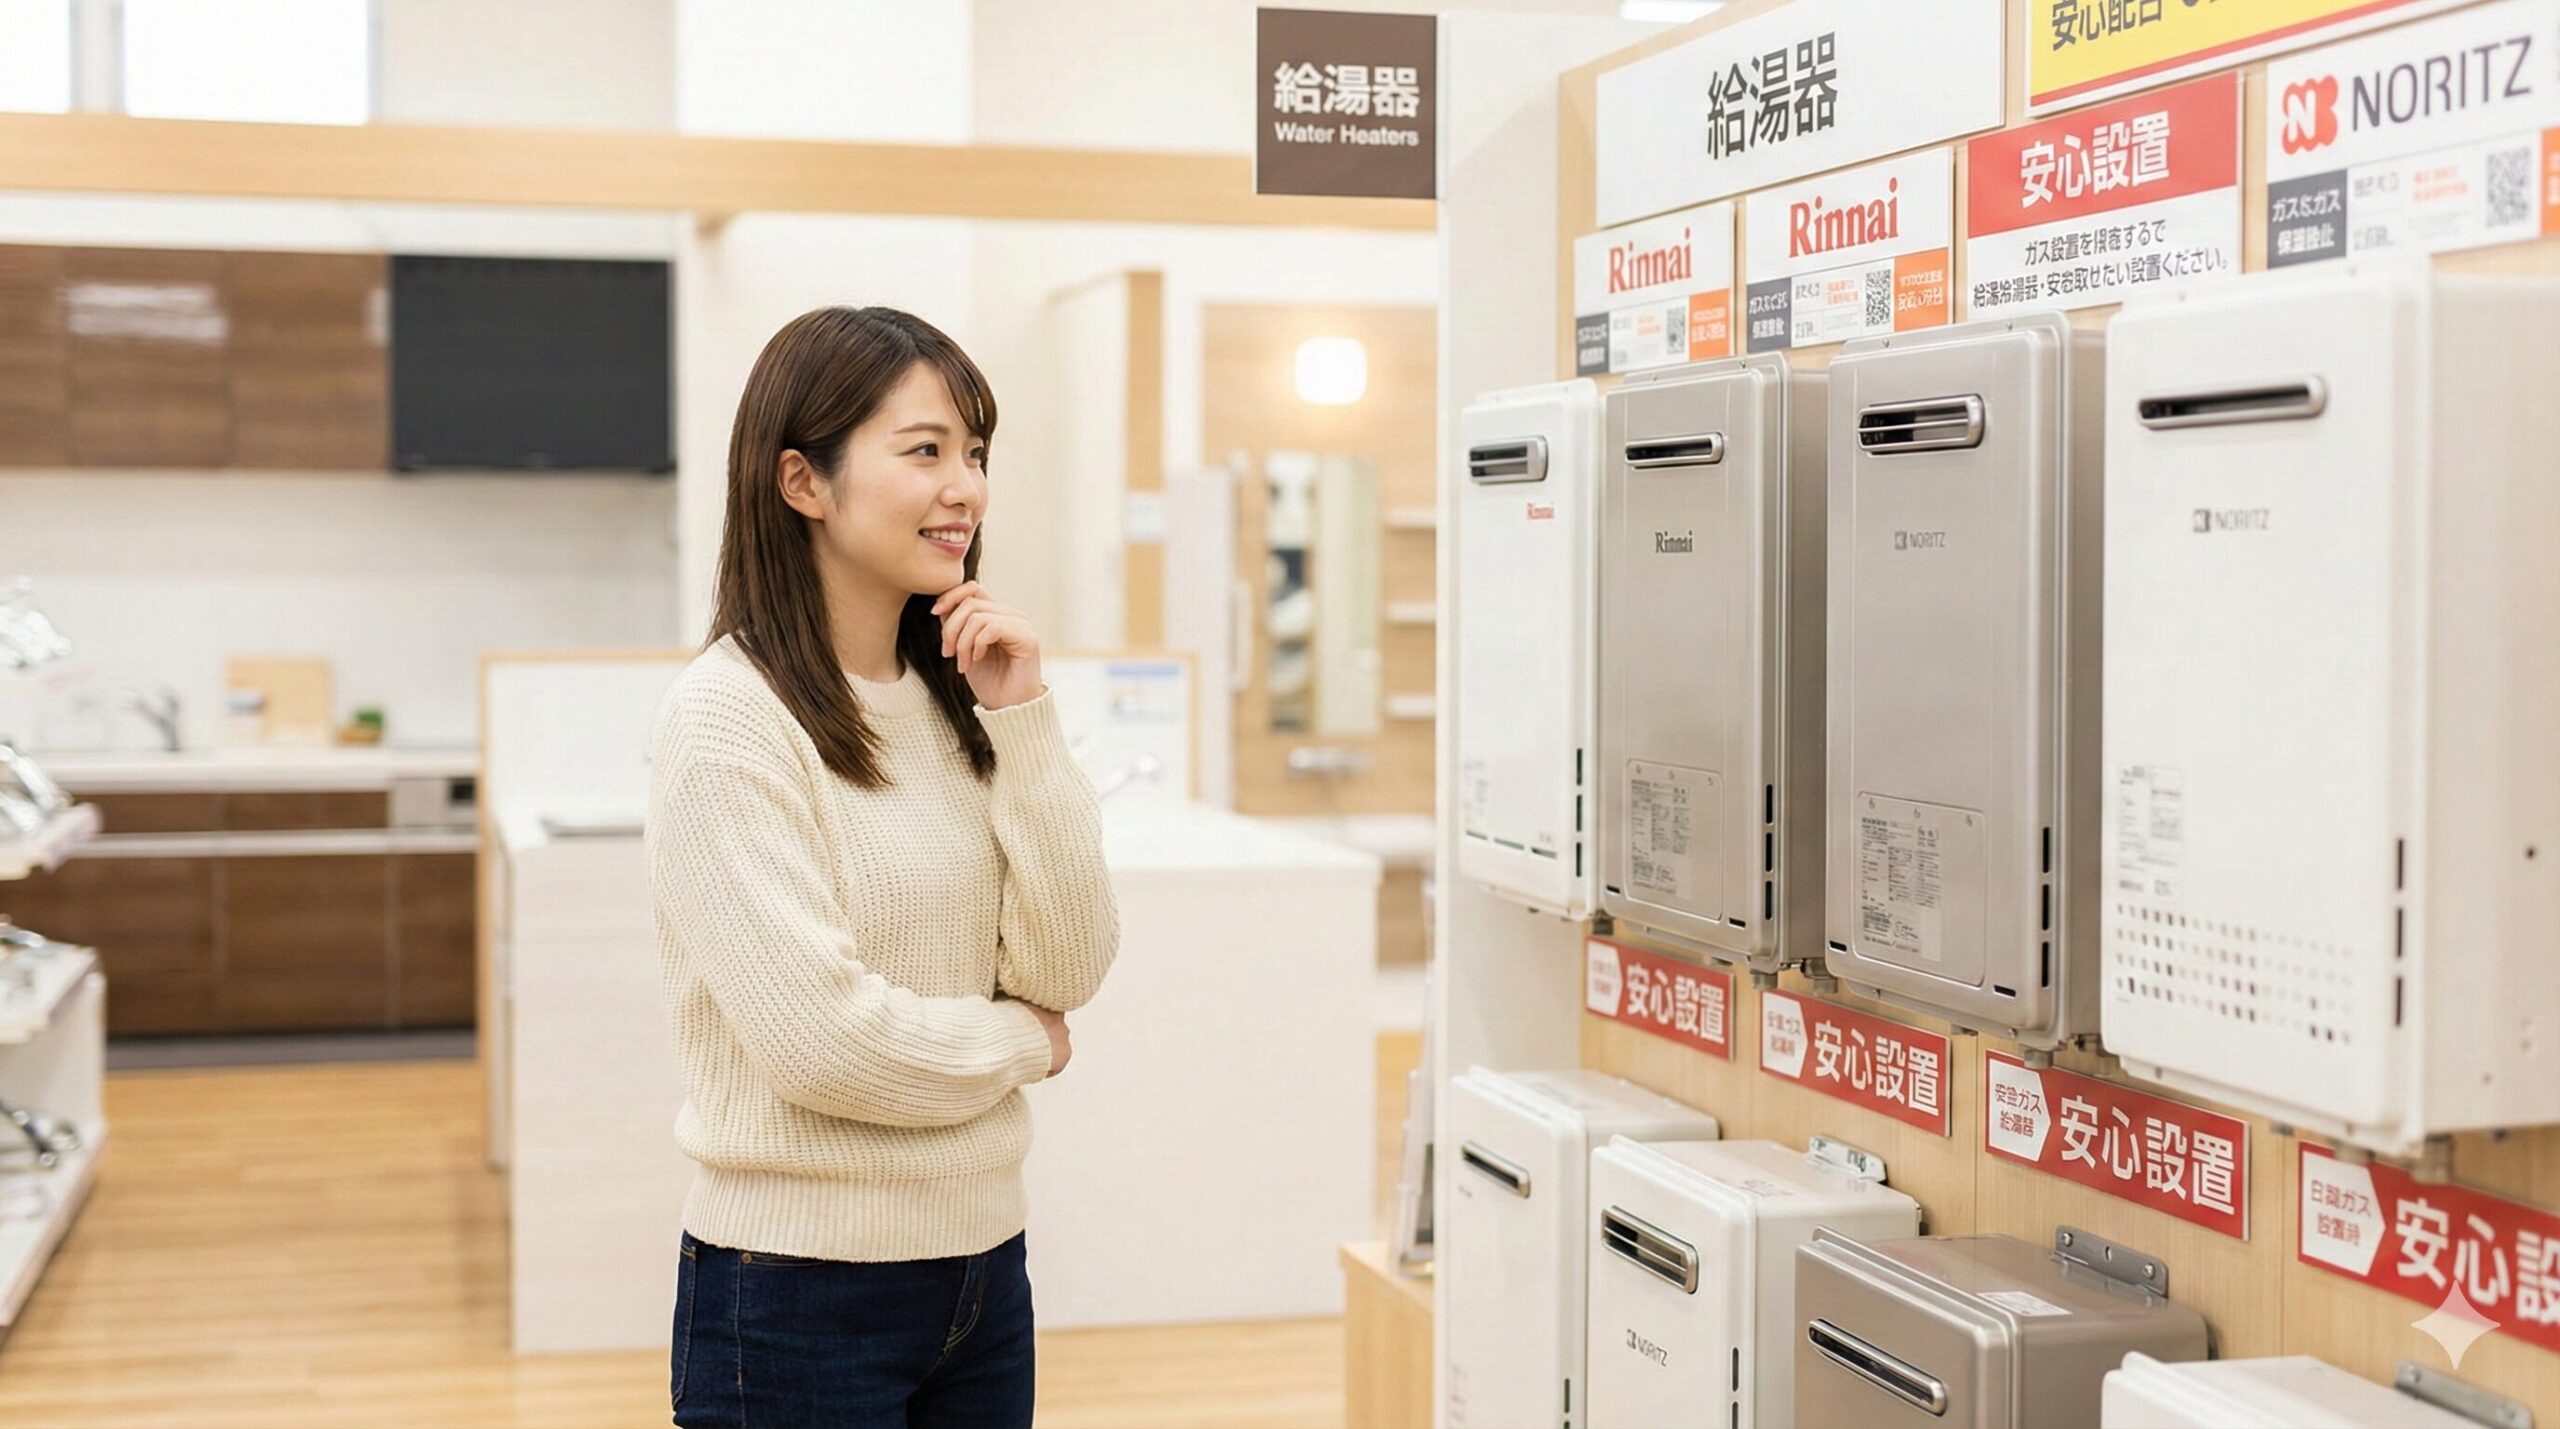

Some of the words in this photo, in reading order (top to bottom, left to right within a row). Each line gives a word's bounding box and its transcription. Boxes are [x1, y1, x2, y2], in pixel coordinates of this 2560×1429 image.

[1274, 61, 1421, 118] 給湯器
[1707, 31, 1839, 161] 給湯器
[2351, 35, 2532, 132] NORITZ
[1274, 121, 1335, 143] Water
[1340, 124, 1420, 146] Heaters
[2019, 110, 2171, 209] 安心設置
[1789, 177, 1899, 258] Rinnai
[1608, 228, 1692, 294] Rinnai
[1655, 530, 1693, 553] Rinnai
[1626, 962, 1725, 1045] 安心設置
[1814, 1019, 1940, 1117] 安心設置
[2060, 1094, 2235, 1215] 安心設置
